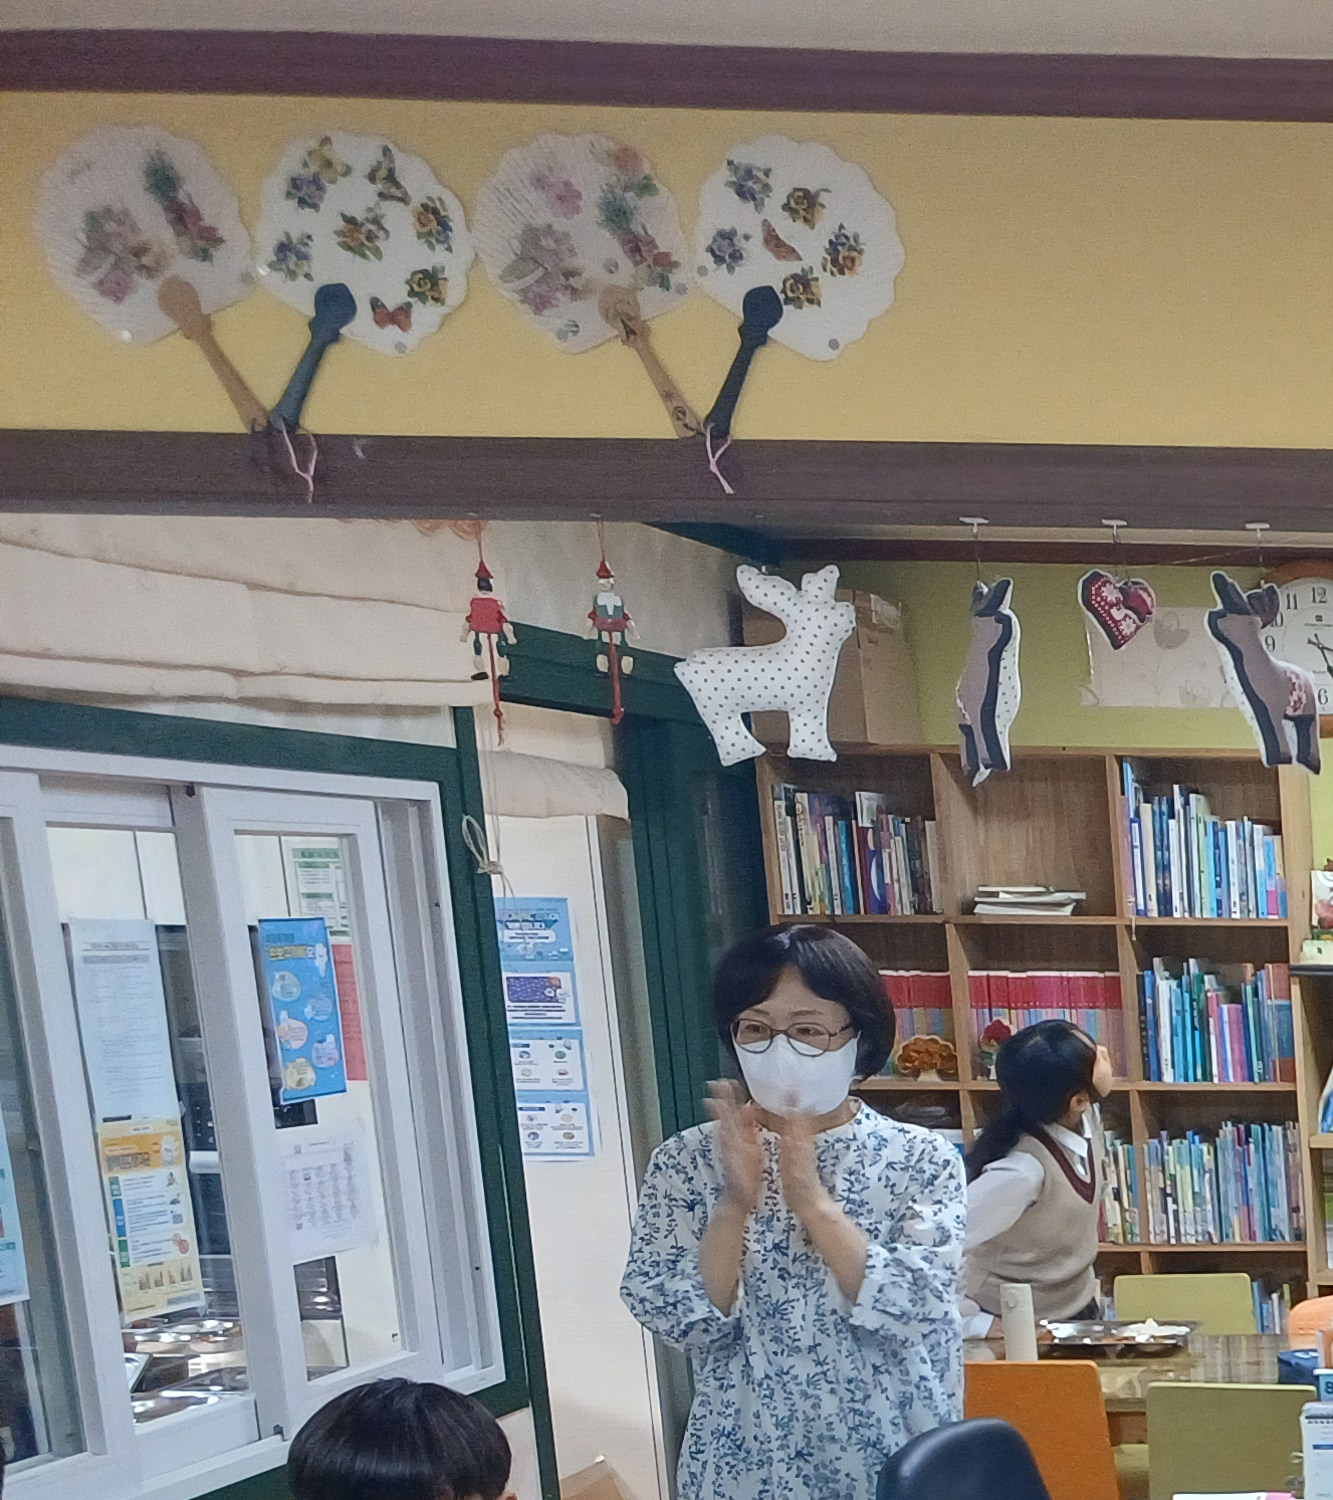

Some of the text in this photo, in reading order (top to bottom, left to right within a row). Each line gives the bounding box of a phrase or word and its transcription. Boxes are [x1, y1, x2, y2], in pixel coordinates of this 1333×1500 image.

[1286, 592, 1298, 610] 11
[1311, 586, 1327, 604] 12
[1264, 635, 1276, 652] 9
[1317, 688, 1328, 705] 6
